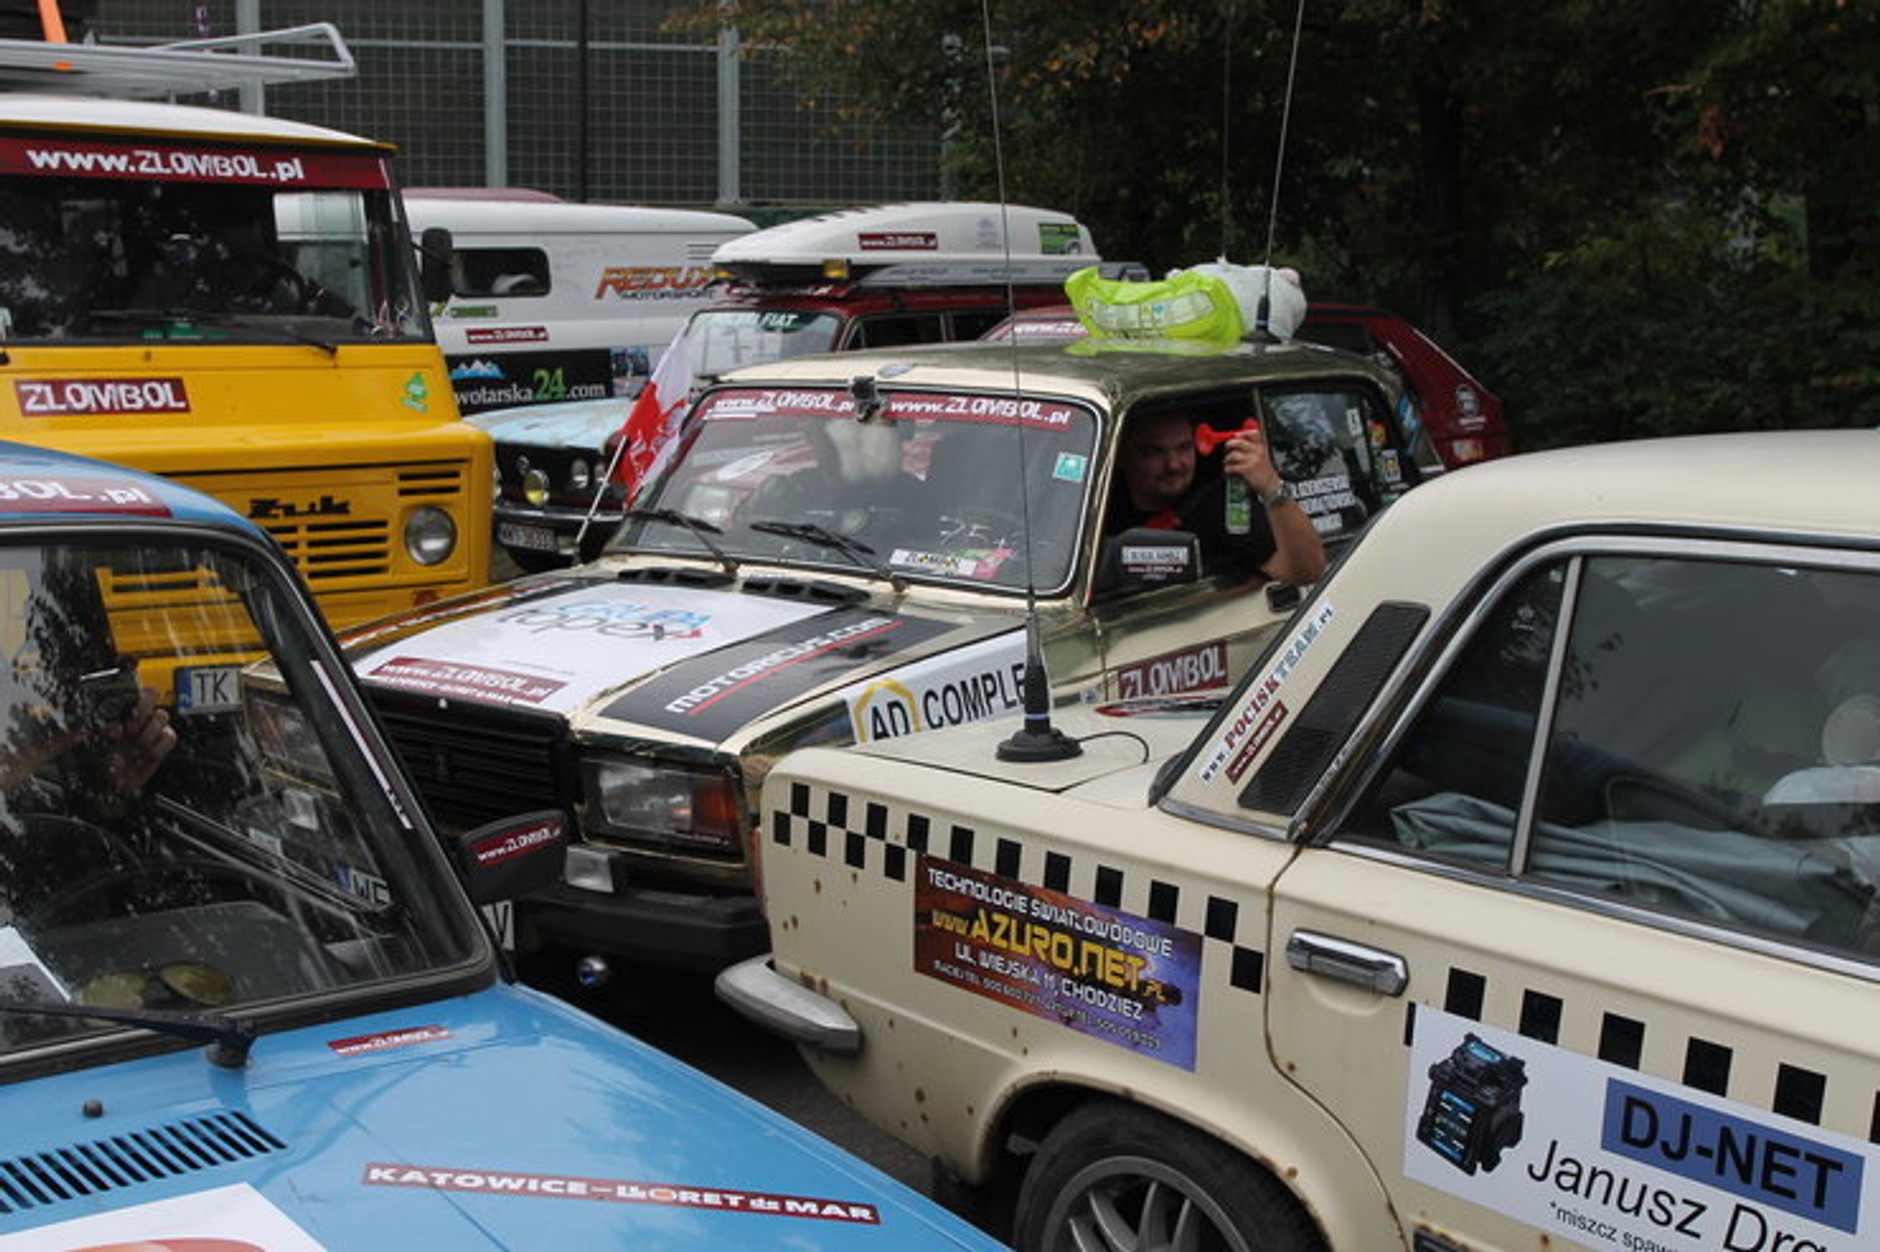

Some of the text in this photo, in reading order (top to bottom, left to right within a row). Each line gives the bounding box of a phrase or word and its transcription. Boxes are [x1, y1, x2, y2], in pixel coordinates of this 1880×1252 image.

[25, 149, 305, 181] www.ZLOMBOL.pl
[19, 382, 187, 413] ZLOMBOL
[891, 396, 1072, 424] www.ZLOMBOL.pl
[194, 671, 229, 704] TK
[1120, 645, 1226, 700] ZLOMBOL
[871, 700, 912, 741] AD
[928, 868, 1027, 914] TECHNOLOGIE
[1620, 1094, 1844, 1210] DJ-NET
[368, 1167, 588, 1195] KATOWICE
[785, 1199, 874, 1221] MAR
[1526, 1139, 1708, 1240] Janusz
